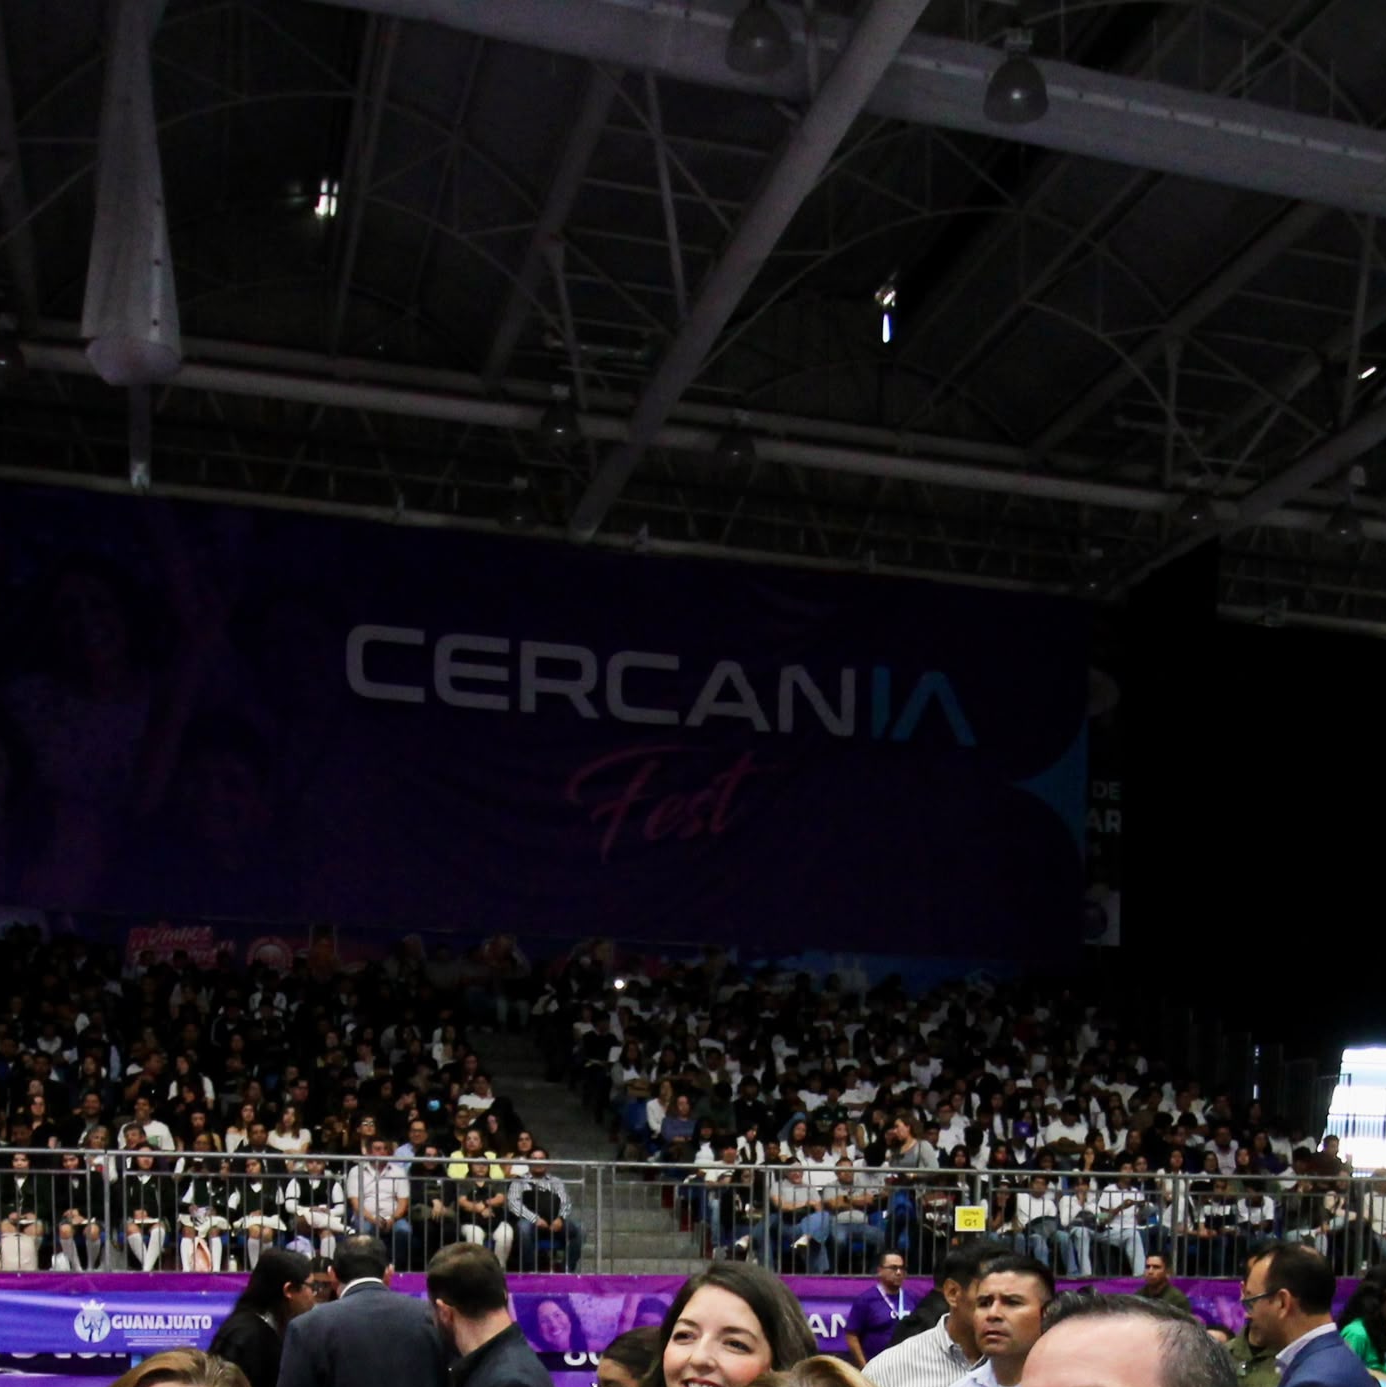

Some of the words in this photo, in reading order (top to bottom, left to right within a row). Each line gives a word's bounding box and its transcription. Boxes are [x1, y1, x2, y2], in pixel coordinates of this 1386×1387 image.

[344, 622, 979, 750] CERCANIA
[565, 742, 785, 865] Fest
[111, 1314, 213, 1330] GUANAJUATO
